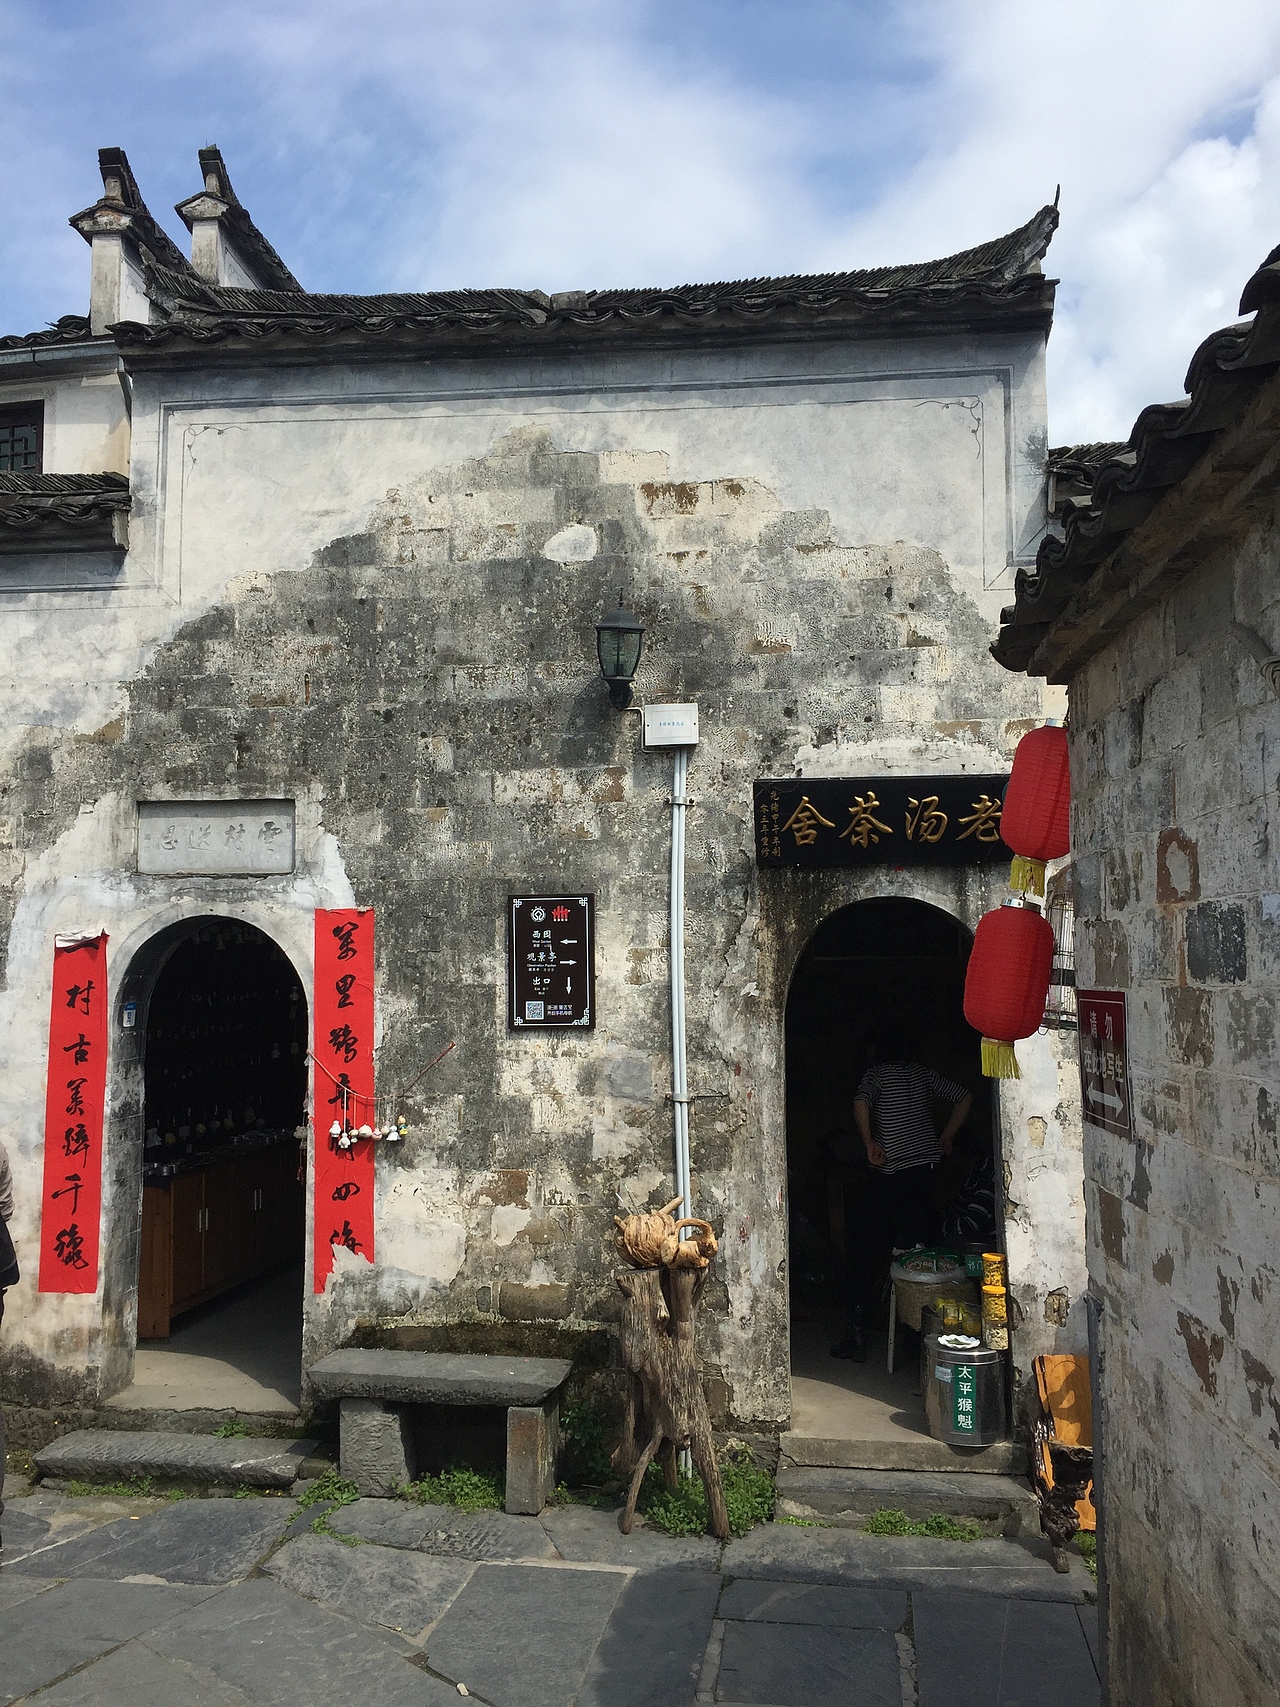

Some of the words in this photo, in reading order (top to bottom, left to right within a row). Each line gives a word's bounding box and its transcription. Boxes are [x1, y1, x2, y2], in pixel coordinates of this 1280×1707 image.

[532, 976, 551, 985] 出口
[1089, 1011, 1112, 1040] 请勿
[1084, 1046, 1123, 1083] 在此地写生
[957, 1366, 973, 1429] 太平猴魁
